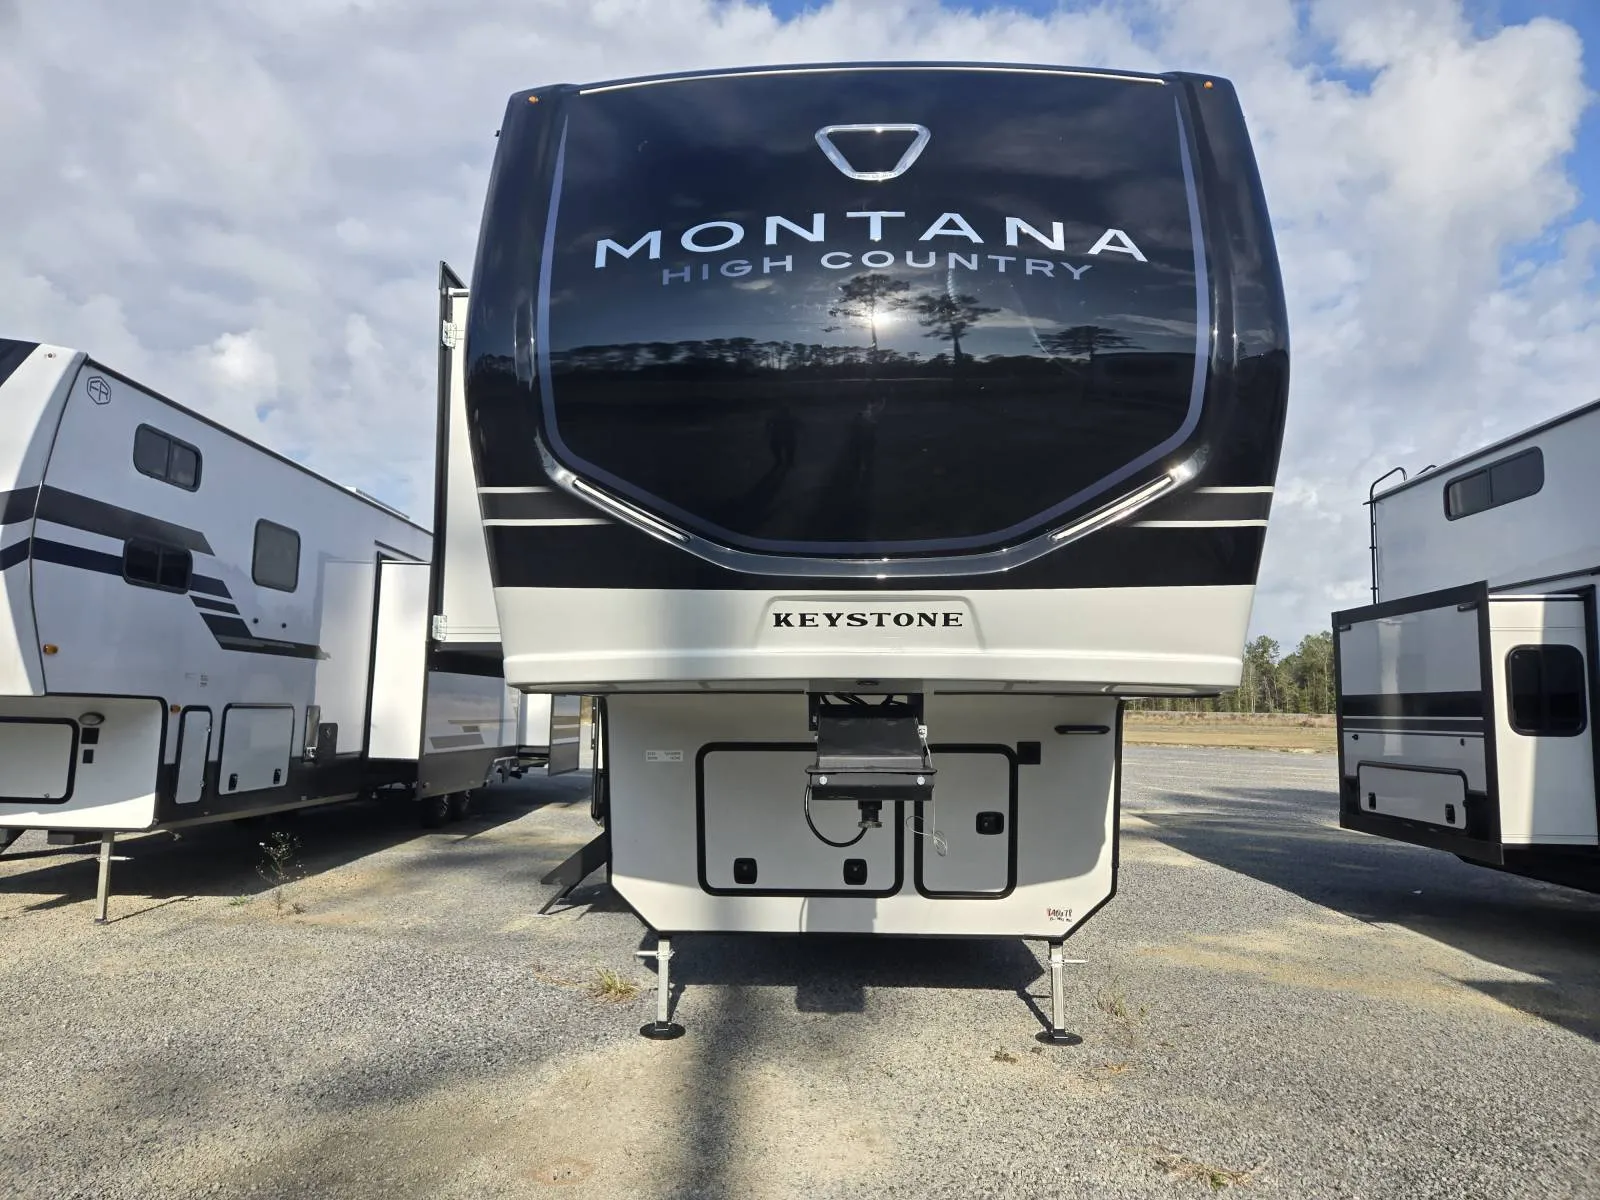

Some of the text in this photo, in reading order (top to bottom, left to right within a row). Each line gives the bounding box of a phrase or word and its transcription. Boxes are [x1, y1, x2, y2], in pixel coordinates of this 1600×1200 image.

[594, 211, 1148, 269] MONTANA
[661, 249, 1093, 286] HIGH COUNTRY
[772, 612, 963, 628] KEYSTONE
